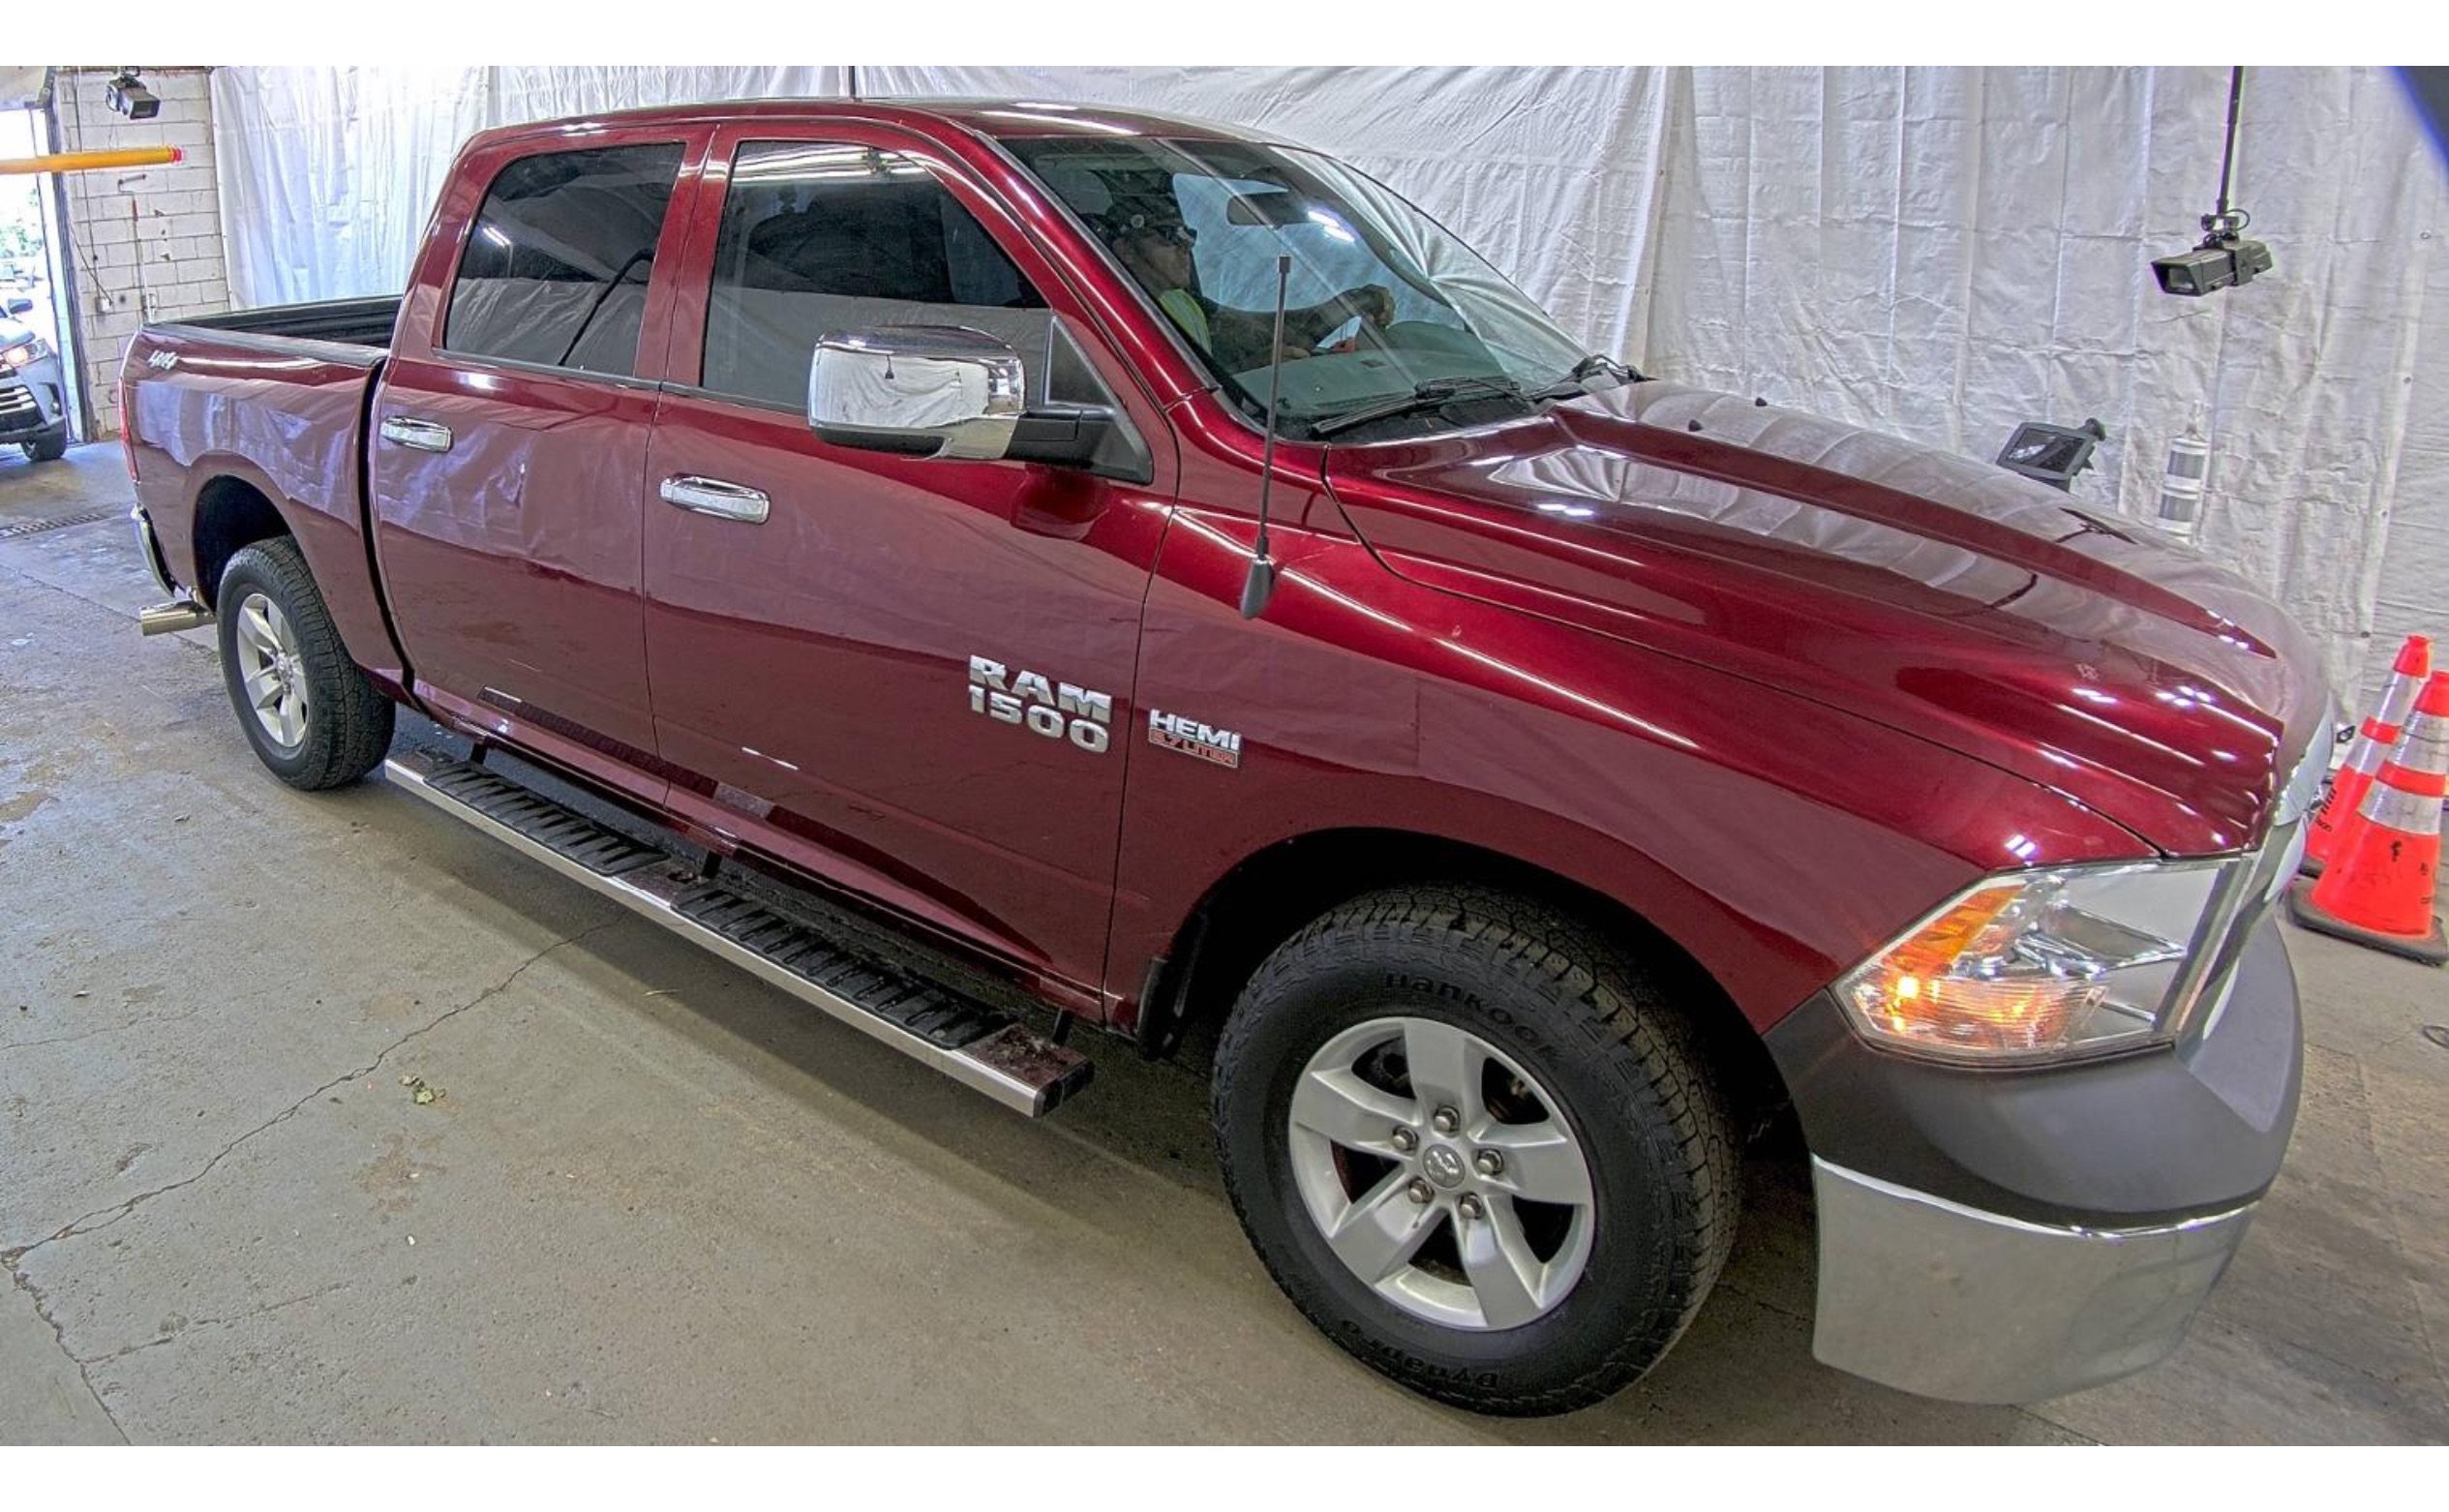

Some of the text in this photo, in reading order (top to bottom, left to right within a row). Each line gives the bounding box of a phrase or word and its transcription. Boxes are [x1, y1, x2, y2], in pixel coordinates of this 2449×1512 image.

[969, 684, 1109, 753] 1500
[970, 654, 1111, 723] RAM
[1150, 709, 1242, 751] HEMI
